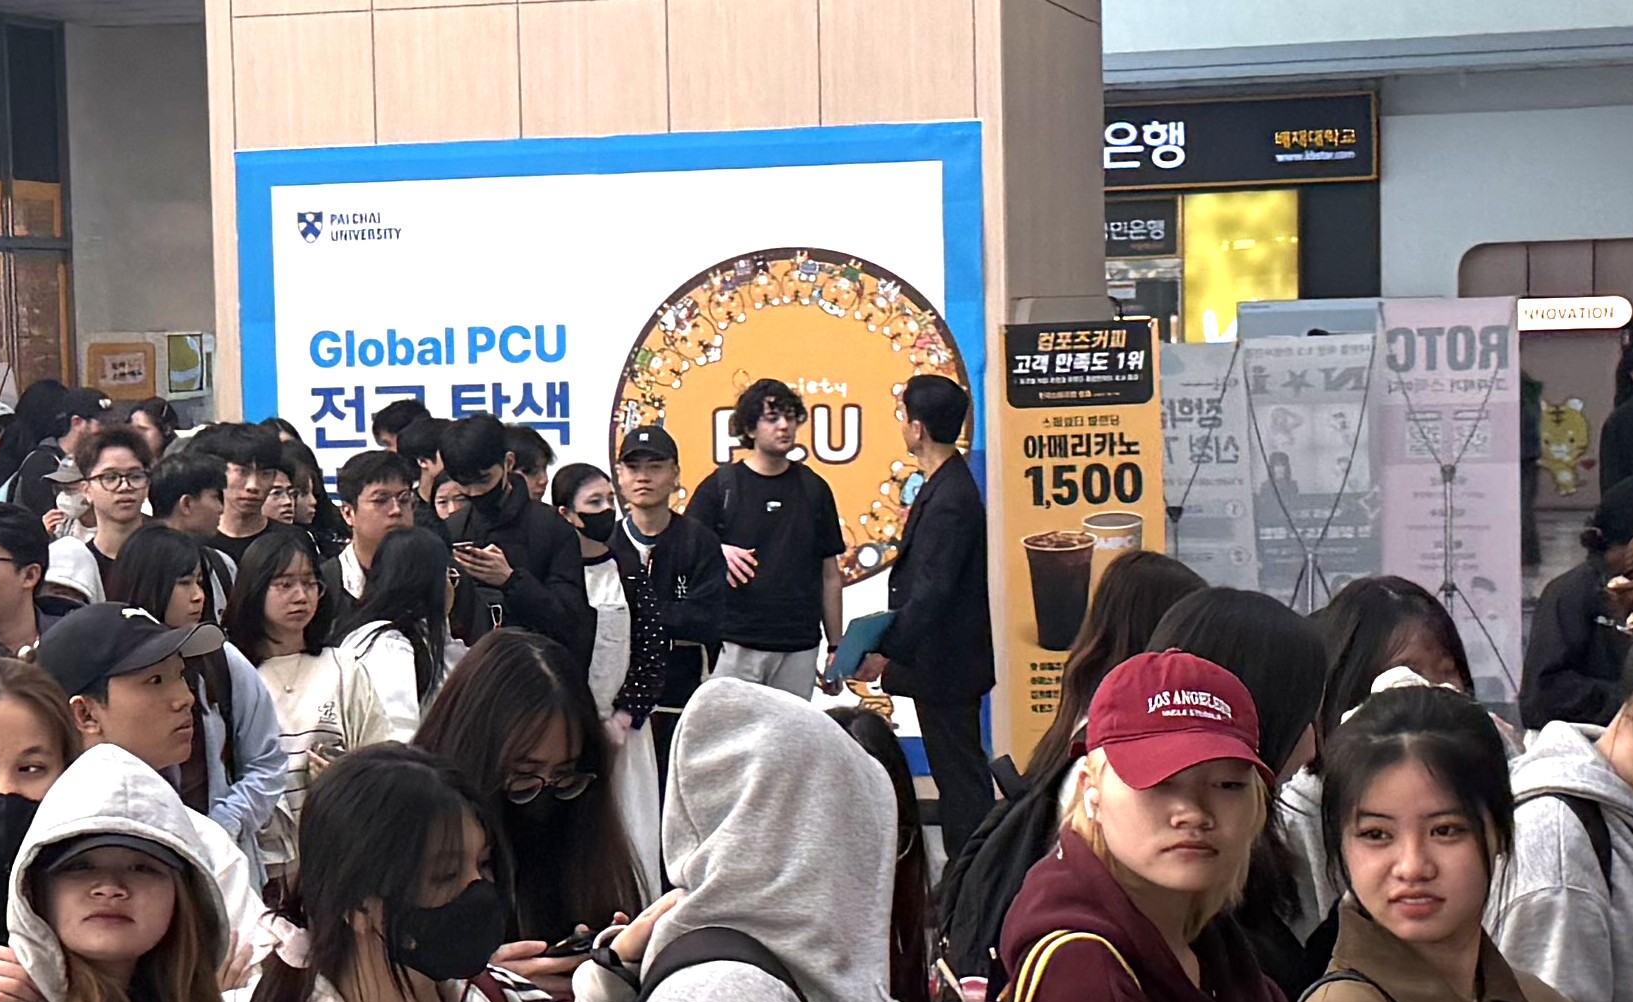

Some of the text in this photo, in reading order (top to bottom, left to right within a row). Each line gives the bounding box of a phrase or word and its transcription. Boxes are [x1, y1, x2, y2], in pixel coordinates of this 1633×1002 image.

[1104, 121, 1186, 169] 은행
[1275, 129, 1356, 147] 배재대학교
[330, 212, 381, 225] PAI CHAI
[1104, 219, 1165, 240] 민은행
[331, 228, 402, 241] UNIVERSITY
[310, 324, 567, 368] Global PCU
[1013, 350, 1145, 374] 고객 만족도 1위
[1024, 432, 1140, 458] 아메리카노
[1024, 462, 1143, 509] 1,500
[1147, 691, 1170, 713] LOS
